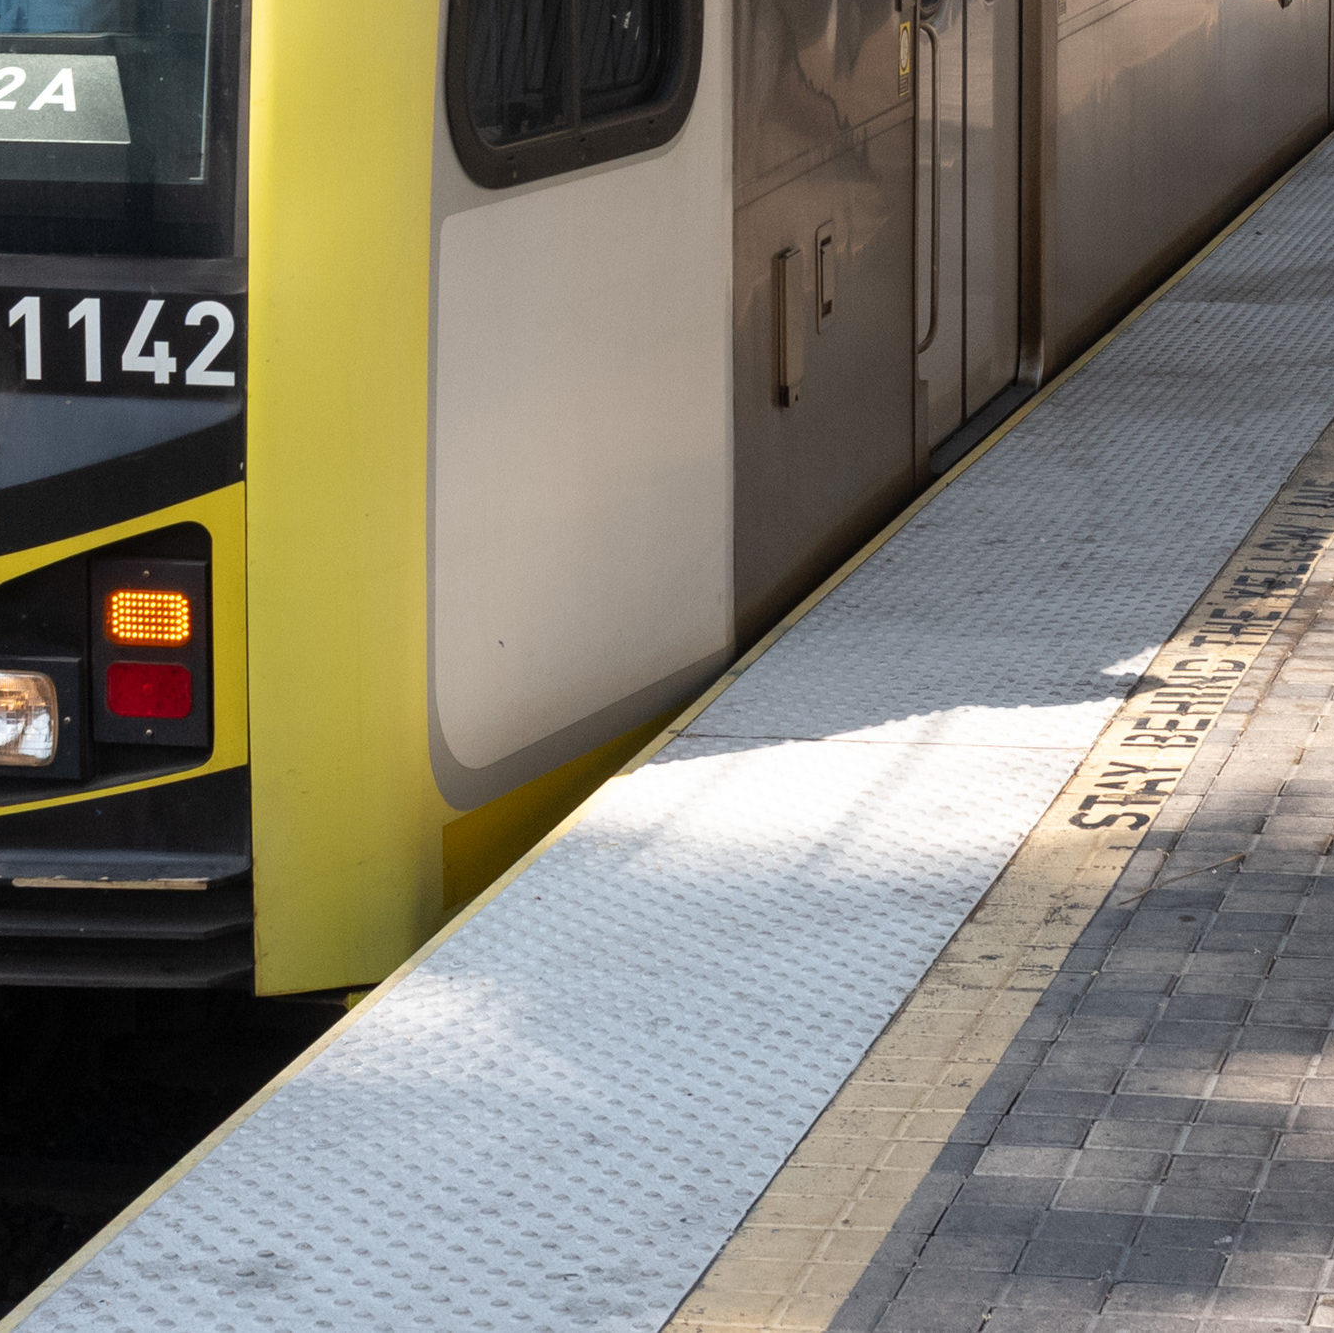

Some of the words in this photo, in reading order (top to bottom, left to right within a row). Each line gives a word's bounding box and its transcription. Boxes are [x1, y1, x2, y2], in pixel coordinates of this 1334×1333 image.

[8, 295, 236, 387] 1142
[1223, 524, 1334, 599] YELLOW
[1188, 608, 1282, 648] THE
[1119, 658, 1247, 749] BEHIND
[1069, 761, 1183, 831] STAY
